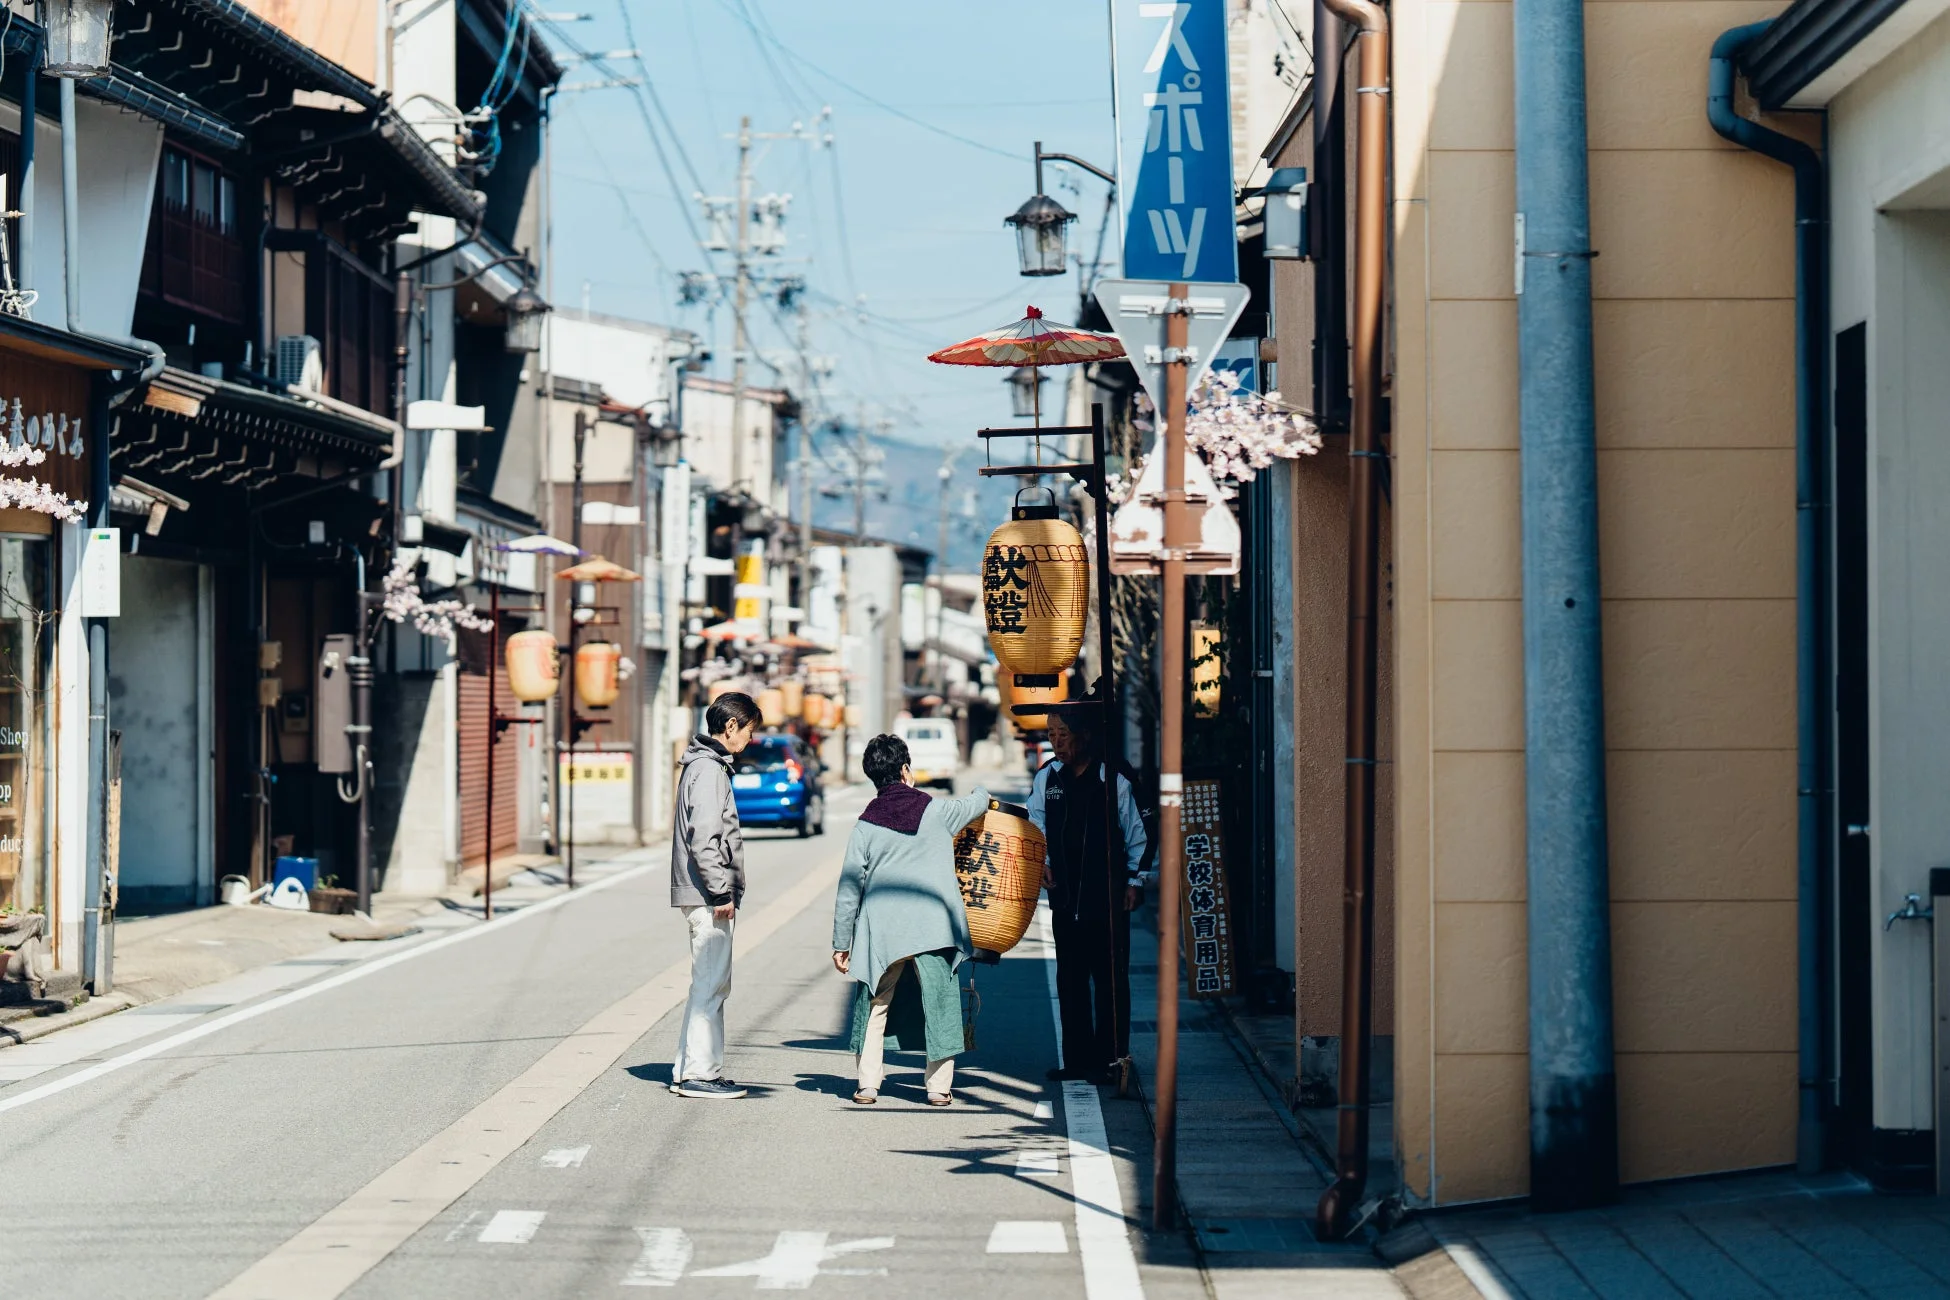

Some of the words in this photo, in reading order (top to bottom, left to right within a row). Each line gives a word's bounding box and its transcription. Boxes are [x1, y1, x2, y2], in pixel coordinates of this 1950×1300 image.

[1139, 3, 1207, 278] スポーツ
[0, 726, 28, 748] Shop
[1185, 834, 1221, 993] 学校体育用品
